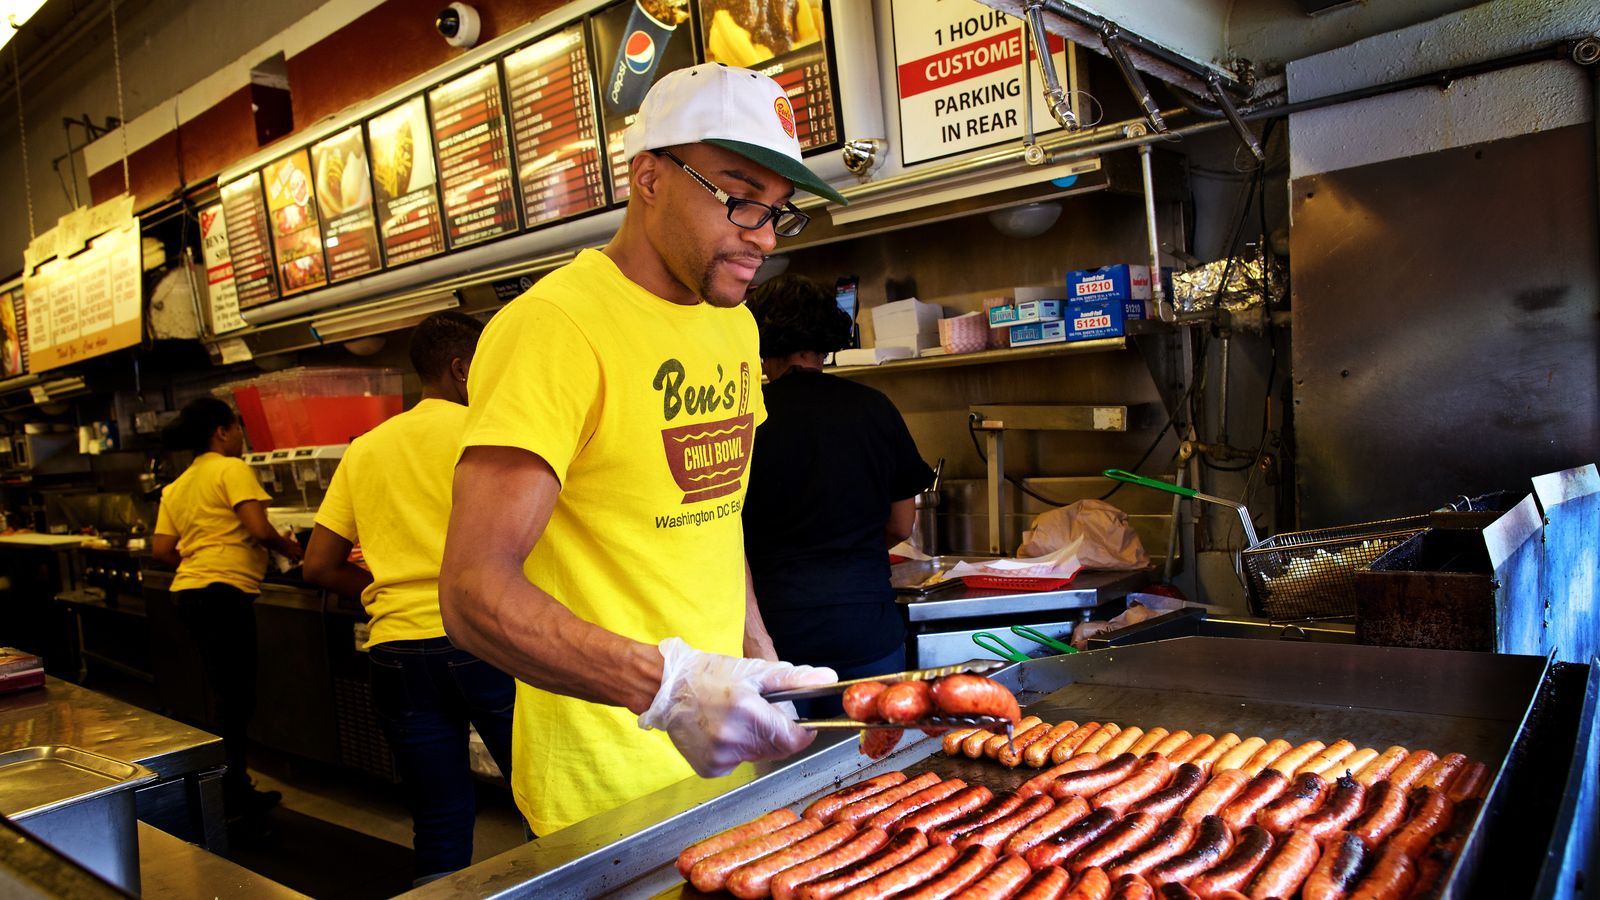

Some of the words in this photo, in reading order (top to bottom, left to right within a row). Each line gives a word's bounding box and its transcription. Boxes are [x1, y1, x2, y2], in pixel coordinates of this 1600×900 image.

[934, 29, 943, 46] 1
[950, 9, 1008, 42] HOUR
[925, 36, 1035, 82] CUSTOME
[611, 60, 627, 104] pepsi
[934, 78, 1021, 117] PARKING
[941, 122, 961, 144] IN
[966, 108, 1018, 138] REAR
[1078, 281, 1111, 294] 51210
[1076, 316, 1108, 329] 51210
[1125, 304, 1141, 313] 51210
[652, 358, 736, 422] Ben's
[684, 442, 713, 472] CHILI
[715, 436, 745, 465] BOWL
[655, 508, 715, 529] Washington
[717, 503, 730, 518] DC
